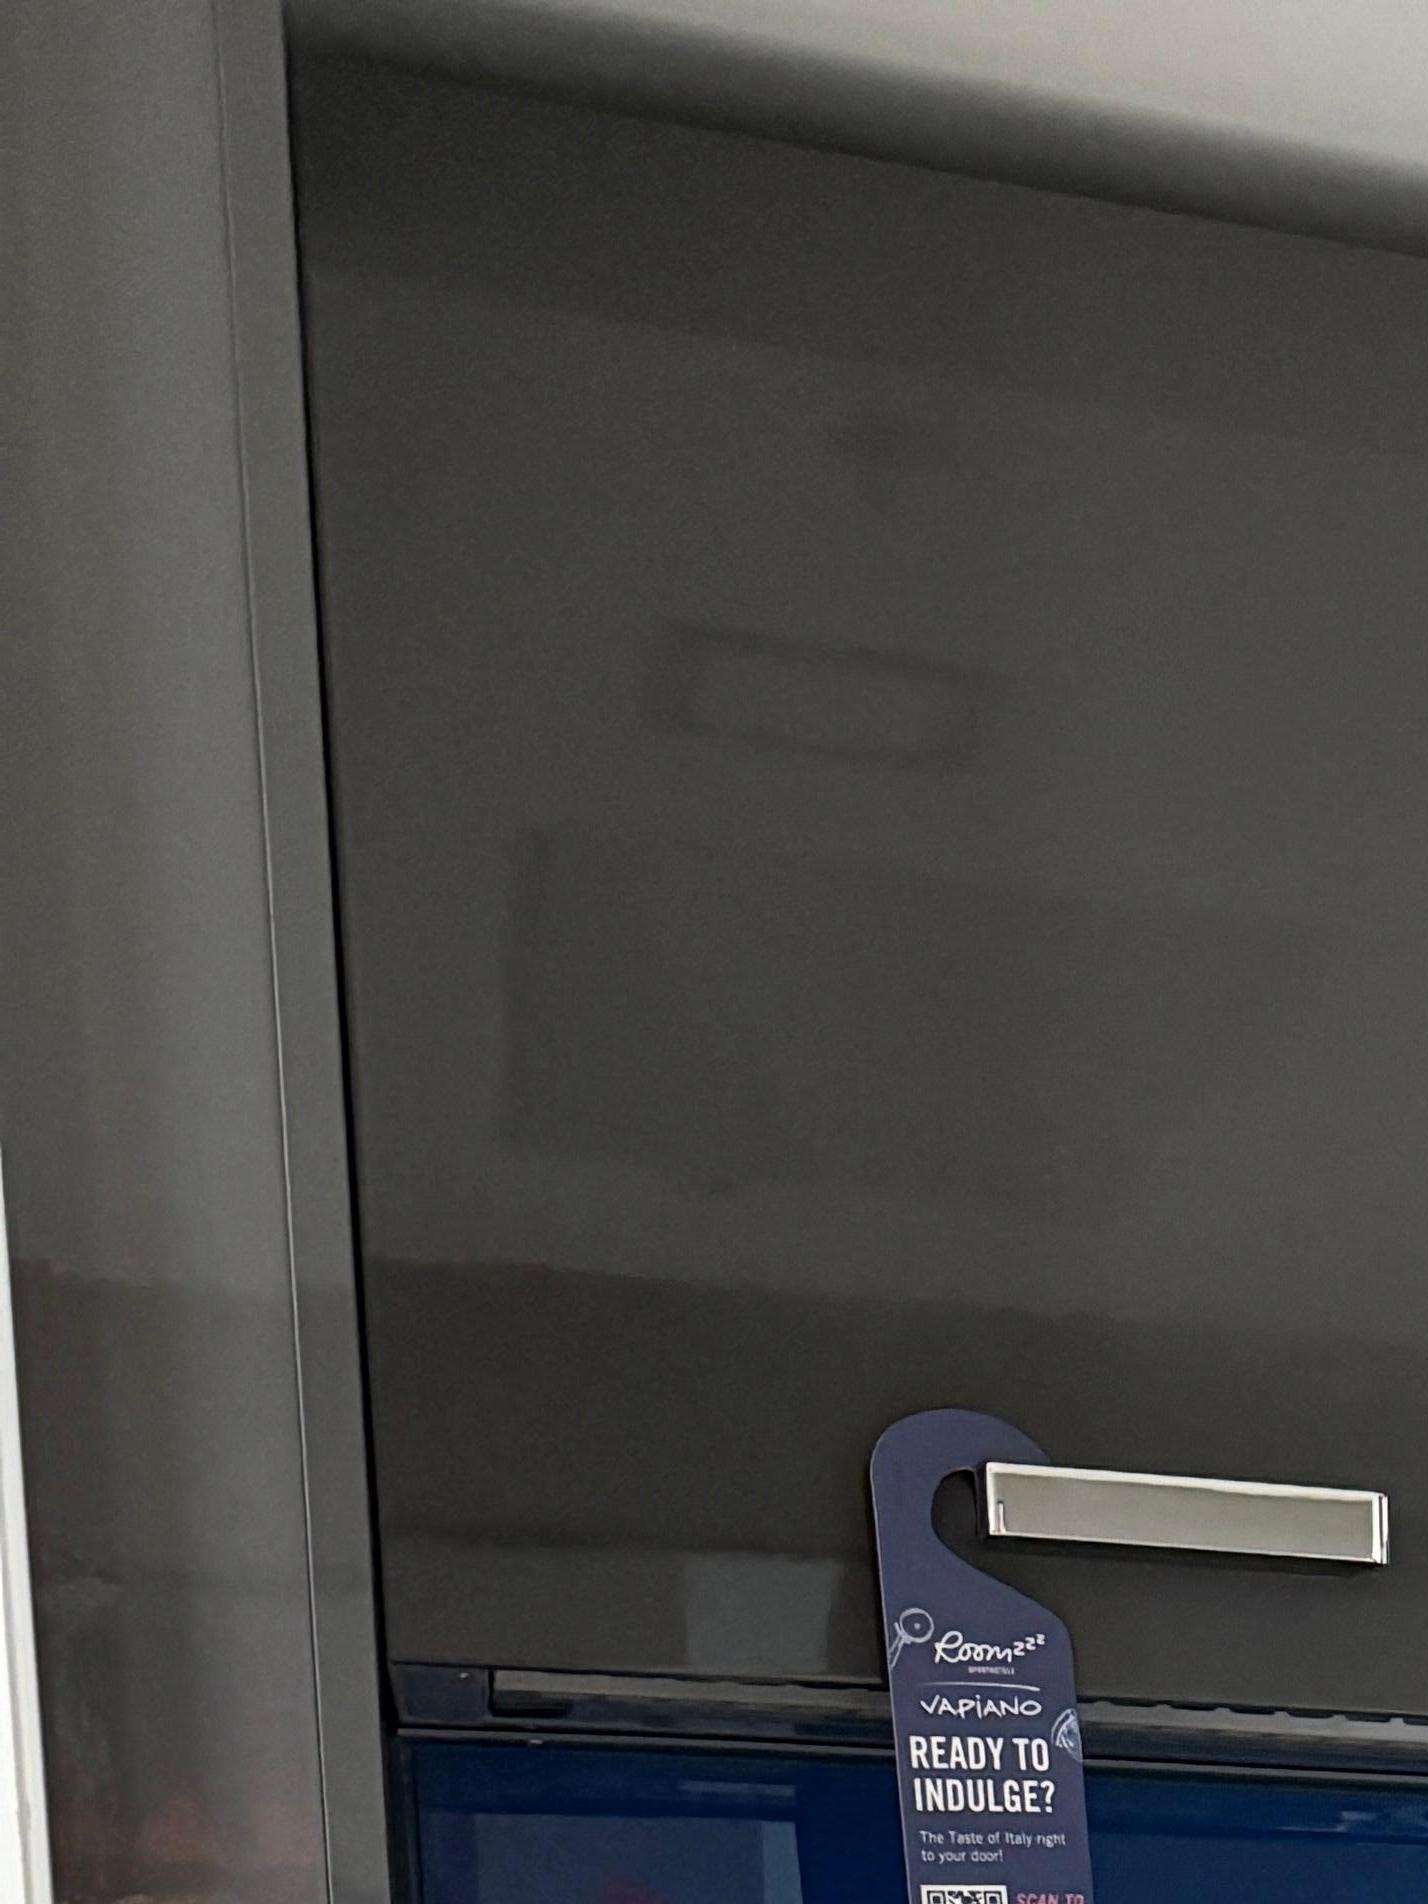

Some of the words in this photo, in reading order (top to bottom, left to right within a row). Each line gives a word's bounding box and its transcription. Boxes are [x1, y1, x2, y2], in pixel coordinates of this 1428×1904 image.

[909, 1736, 1004, 1771] READY
[1012, 1738, 1050, 1771] TO
[913, 1778, 1055, 1813] INDULGE?
[919, 1831, 944, 1844] The
[949, 1831, 983, 1845] Taste
[987, 1832, 1000, 1845] of
[1005, 1832, 1032, 1848] Italy
[1036, 1833, 1066, 1848] right
[921, 1850, 935, 1862] to
[939, 1852, 965, 1864] your
[971, 1850, 1003, 1862] door!
